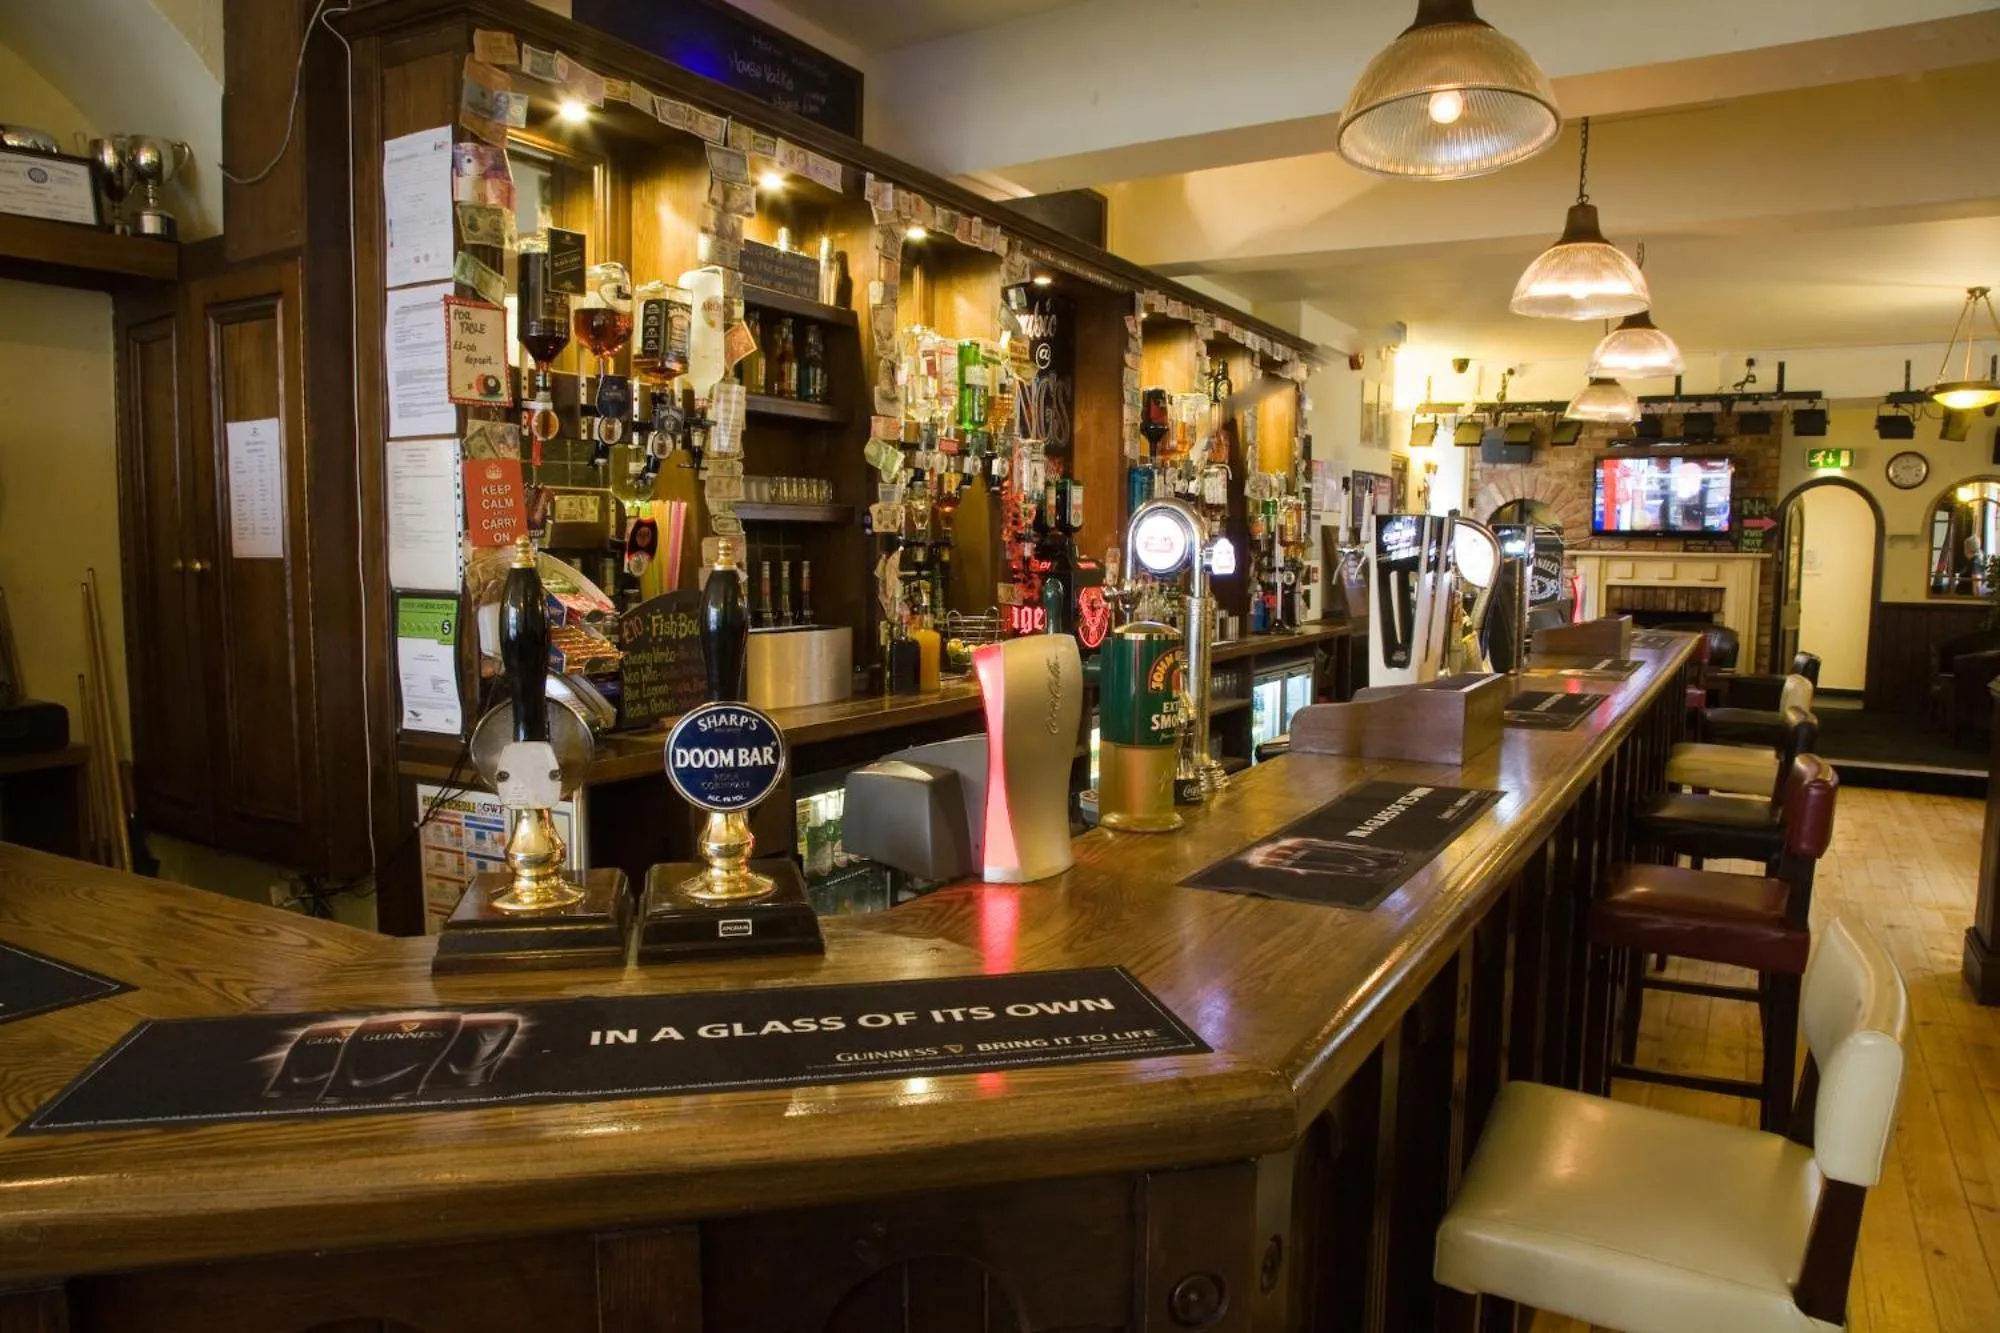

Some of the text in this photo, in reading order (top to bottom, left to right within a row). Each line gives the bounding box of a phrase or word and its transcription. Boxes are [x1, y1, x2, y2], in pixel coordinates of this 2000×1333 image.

[481, 483, 512, 496] KEEP
[481, 497, 514, 510] CALM
[481, 517, 518, 531] CARRY
[492, 531, 511, 543] ON
[441, 620, 451, 635] 5
[697, 713, 760, 733] SHARP'S
[675, 746, 776, 769] DOOM BAR
[589, 997, 1116, 1047] IN A GLASS OF ITS OWN
[362, 1031, 445, 1042] GUINNESS
[835, 1027, 1161, 1063] GUINNESS BRING IT TO LIFE
